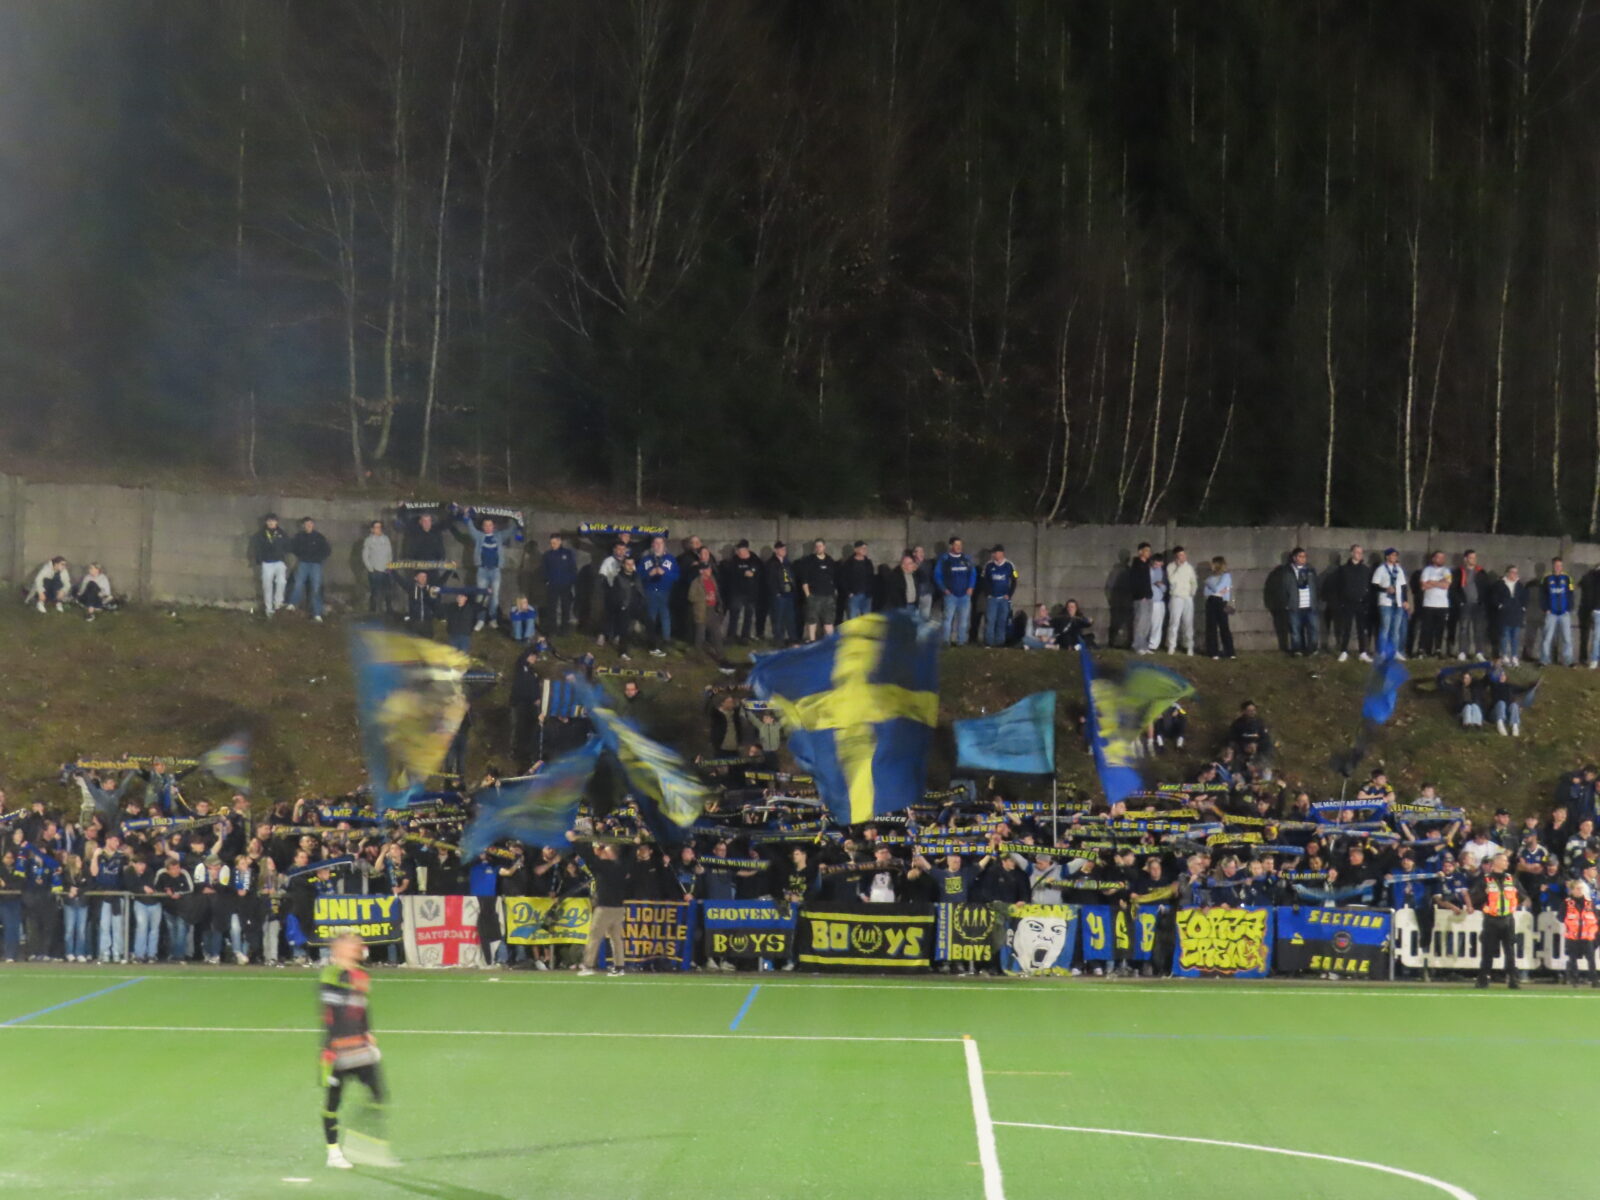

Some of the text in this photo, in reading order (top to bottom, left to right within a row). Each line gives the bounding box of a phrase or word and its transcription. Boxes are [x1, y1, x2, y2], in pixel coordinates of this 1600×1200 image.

[314, 897, 394, 920] UNITY
[626, 907, 677, 923] LIQUE
[620, 923, 688, 940] NAILLE
[1176, 909, 1268, 938] FORZA
[625, 939, 676, 957] LTRAS
[952, 943, 992, 961] BOYS
